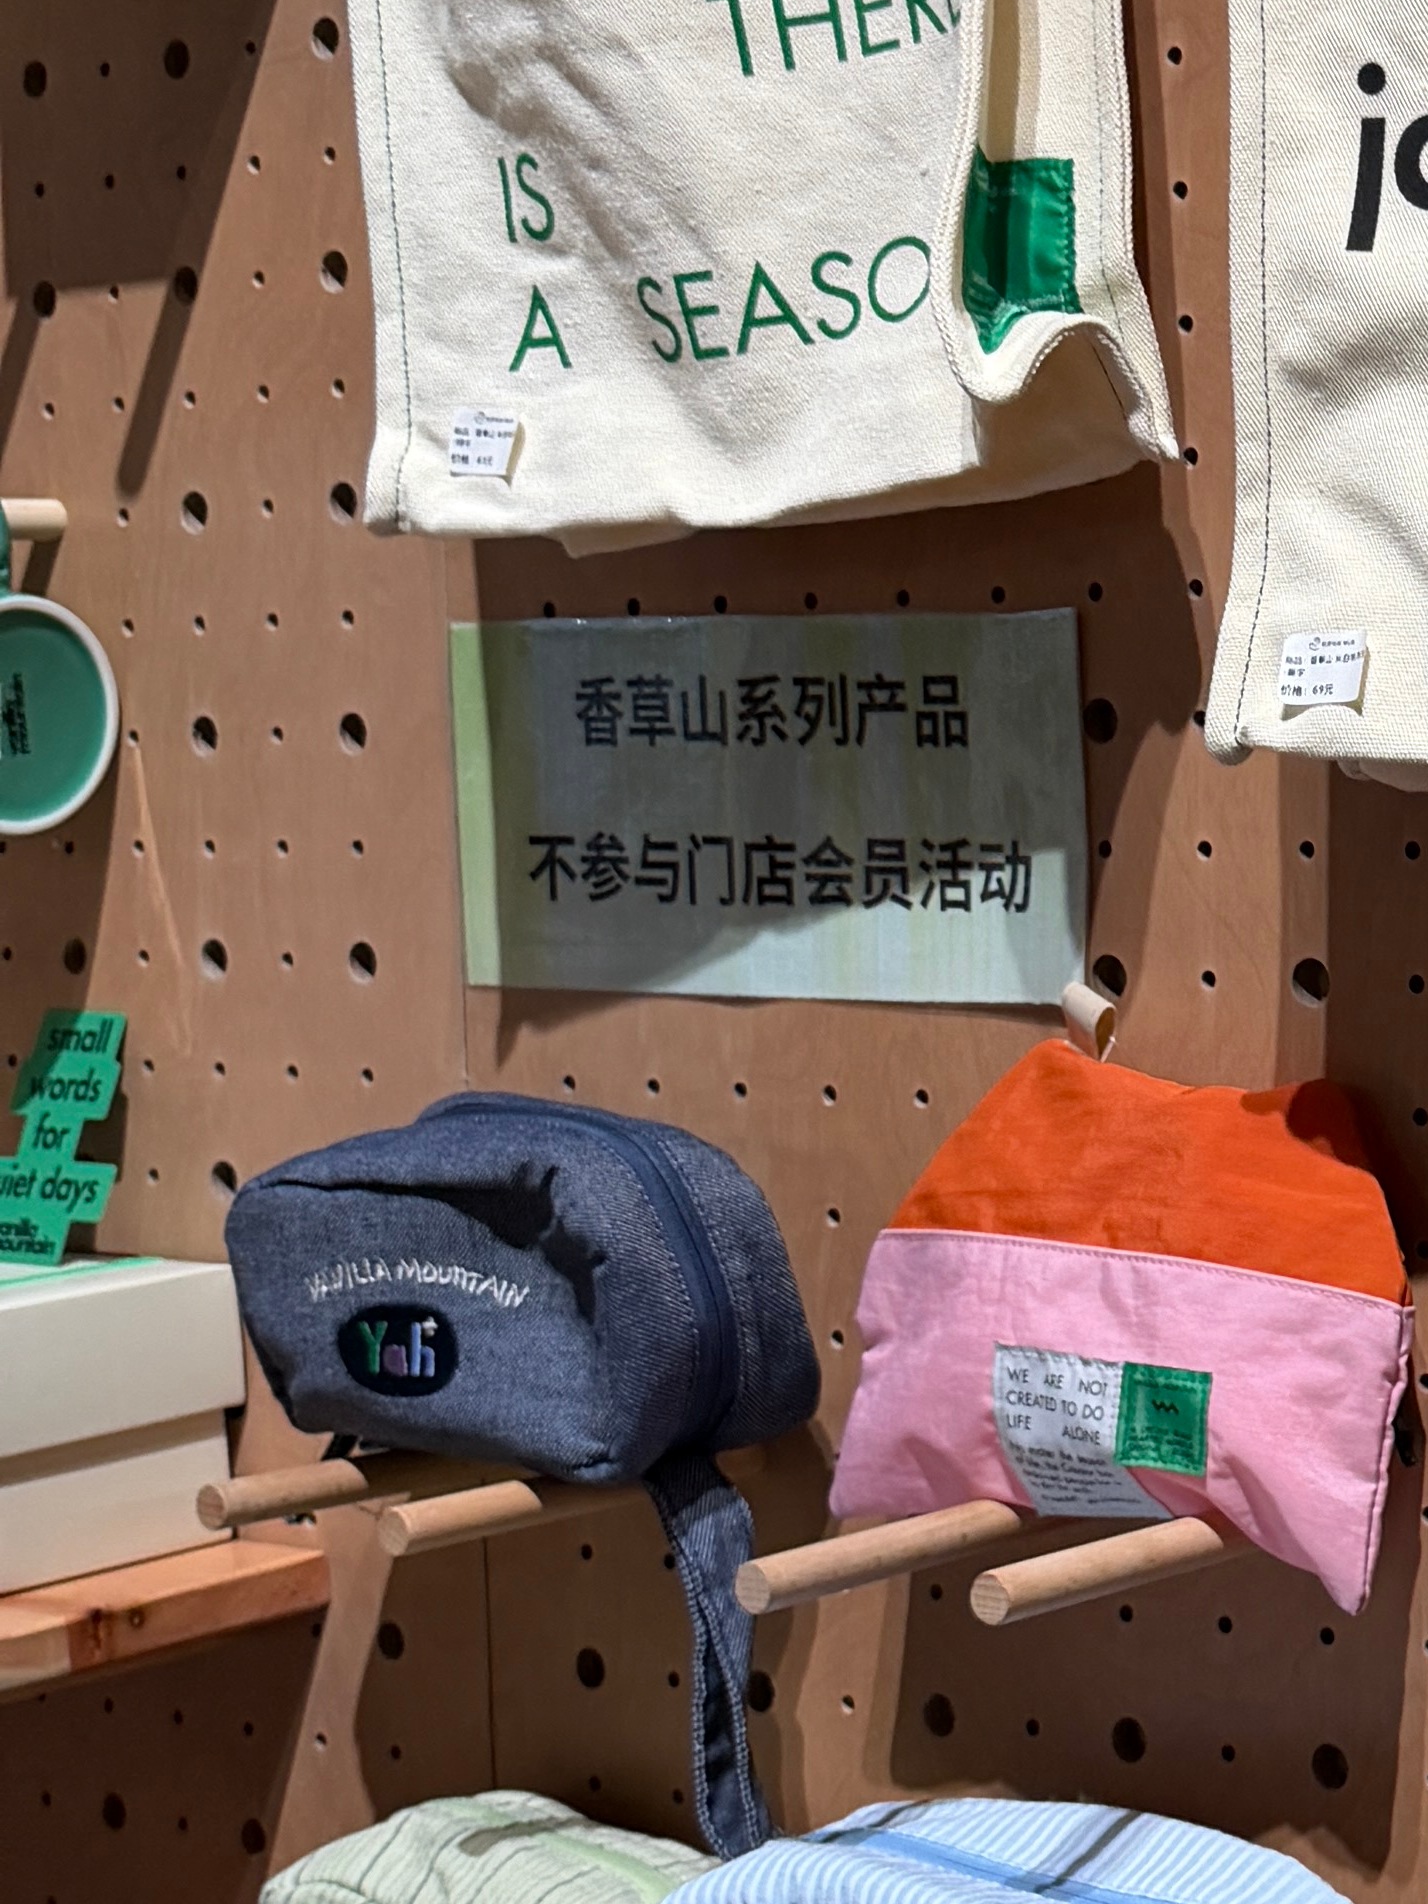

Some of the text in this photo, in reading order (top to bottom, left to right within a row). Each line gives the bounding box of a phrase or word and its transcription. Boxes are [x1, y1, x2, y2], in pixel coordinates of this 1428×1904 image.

[497, 153, 555, 244] IS
[509, 234, 934, 373] A SEASO
[576, 673, 969, 749] 香草山系列产品
[529, 830, 1032, 914] 不参与门店会员活动
[50, 1018, 113, 1054] small
[31, 1068, 103, 1102] words
[33, 1112, 71, 1149] for
[41, 1165, 100, 1214] days
[396, 1257, 530, 1308] MOUNTAIN
[358, 1318, 437, 1378] Yah
[1006, 1390, 1105, 1422] CREATED TO DO
[1007, 1366, 1108, 1397] WE ARE NOT
[1006, 1413, 1101, 1446] LIFE ALONE
